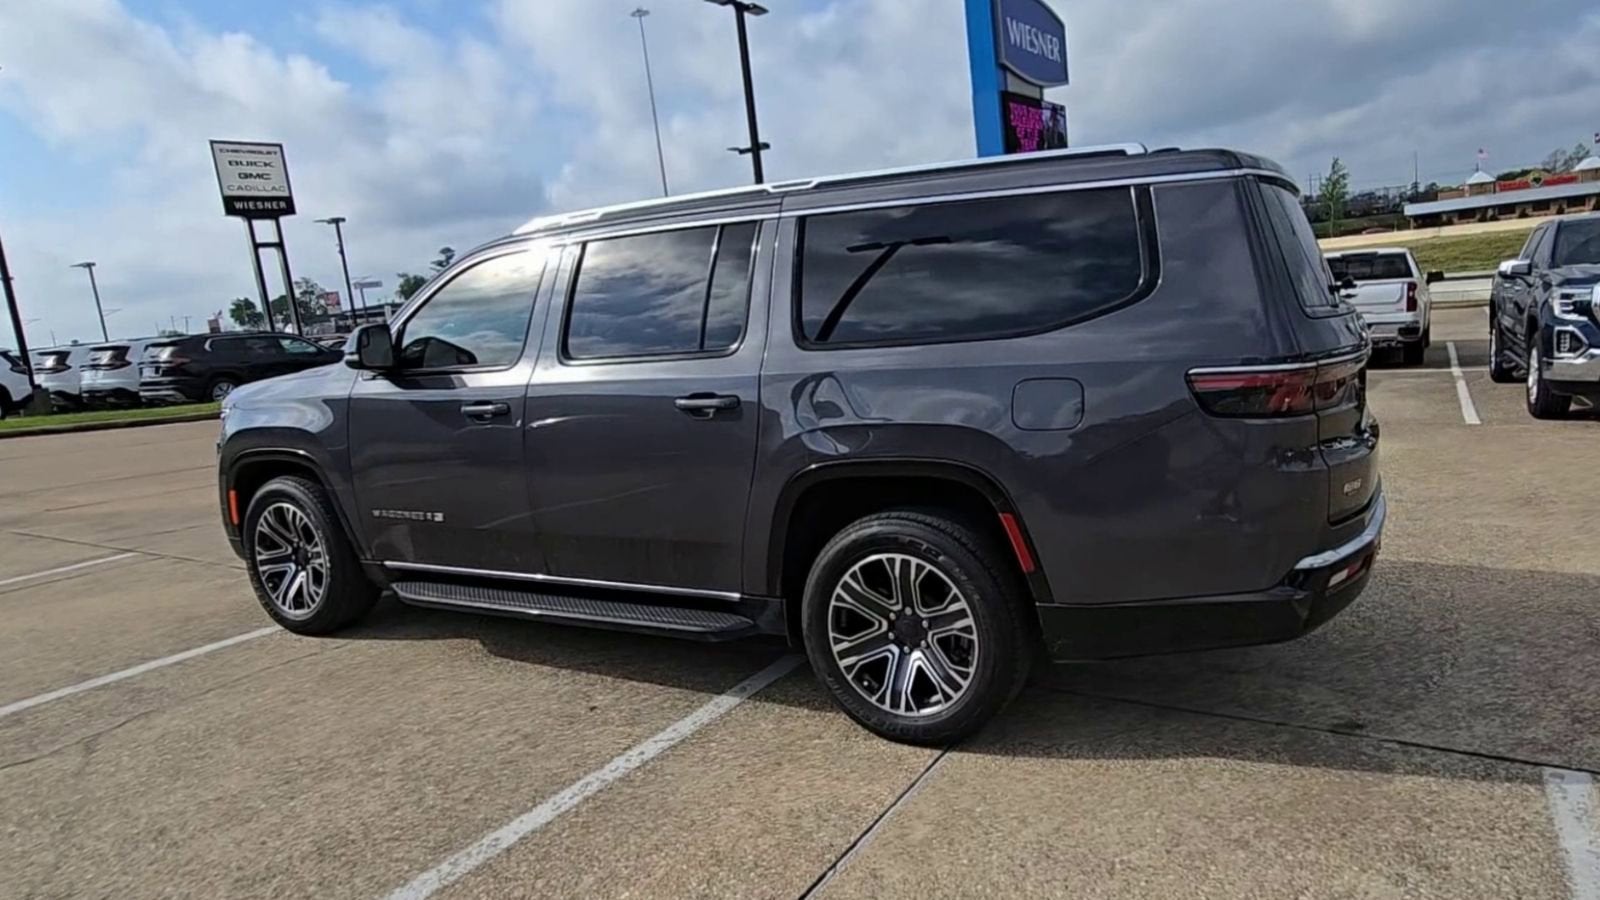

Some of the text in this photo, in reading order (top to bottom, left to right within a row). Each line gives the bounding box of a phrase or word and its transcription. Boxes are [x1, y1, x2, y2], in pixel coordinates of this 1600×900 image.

[1006, 17, 1061, 62] WIESNER
[228, 160, 275, 168] BUICK
[238, 172, 272, 180] GMC
[226, 184, 287, 192] CADILLAC
[233, 201, 287, 210] WIESNER
